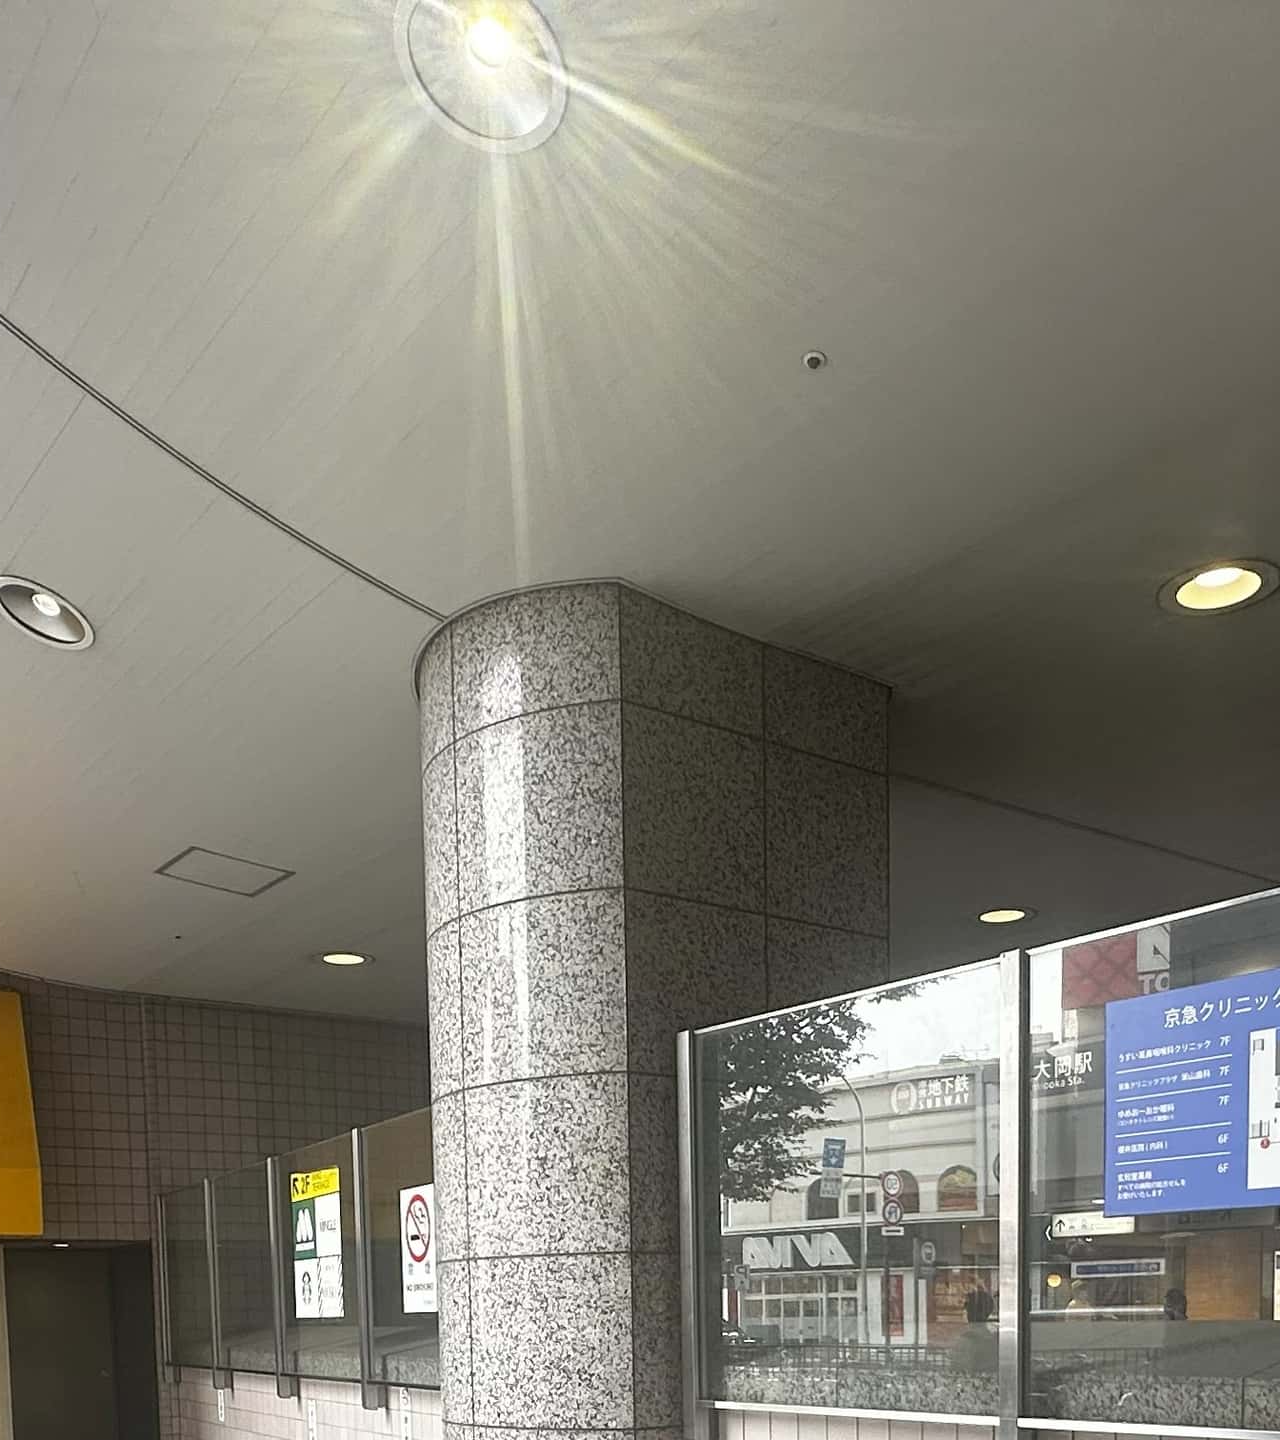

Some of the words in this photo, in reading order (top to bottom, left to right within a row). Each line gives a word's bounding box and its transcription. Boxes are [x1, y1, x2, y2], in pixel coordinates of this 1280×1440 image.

[1219, 1035, 1231, 1048] 7F
[1219, 1065, 1231, 1077] 7F
[1218, 1095, 1230, 1107] 7F
[1217, 1133, 1229, 1145] 6F
[1217, 1163, 1229, 1174] 6F
[301, 1175, 310, 1195] 2F
